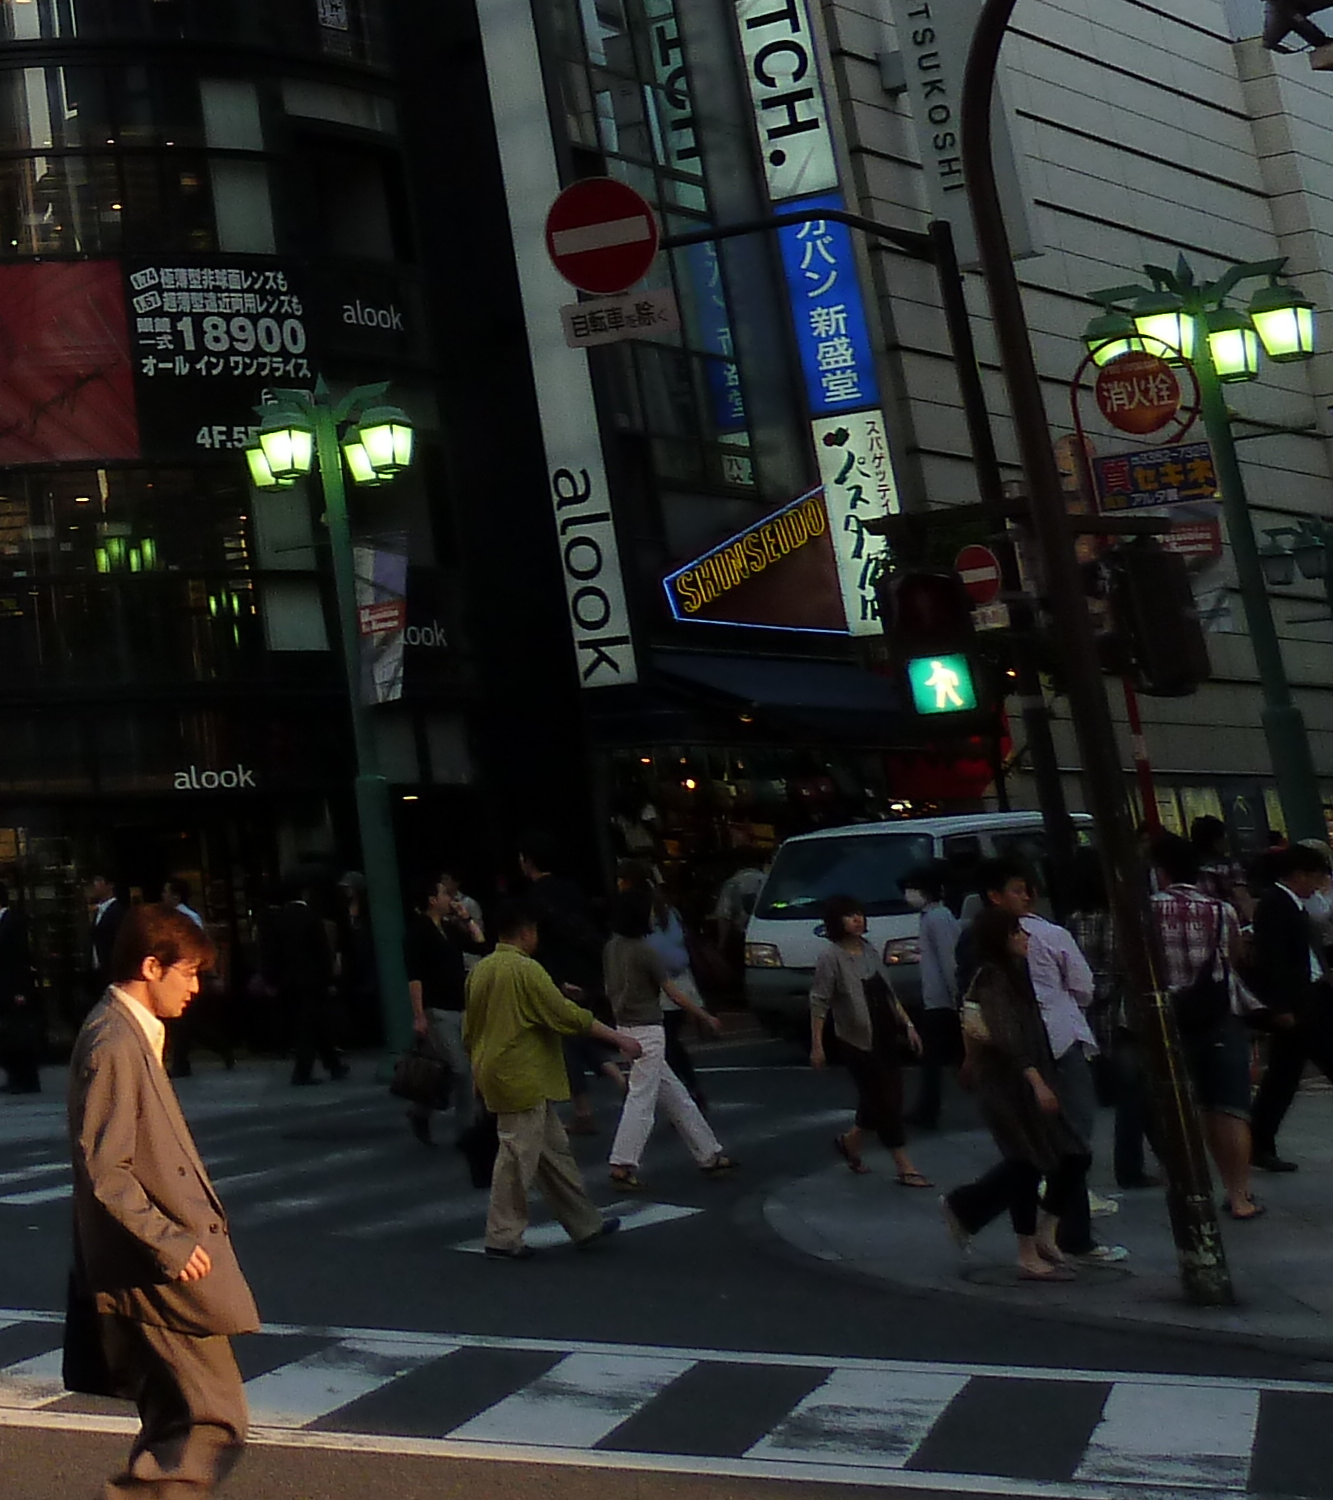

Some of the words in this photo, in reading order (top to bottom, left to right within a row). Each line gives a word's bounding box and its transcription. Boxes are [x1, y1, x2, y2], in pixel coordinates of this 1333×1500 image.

[160, 267, 288, 292] 極薄型非球面レンズも
[163, 291, 304, 317] 超薄型遠近両用レンズも
[341, 300, 405, 332] alook
[570, 300, 671, 339] 自転車を除く
[138, 334, 175, 351] 一式
[176, 316, 308, 355] 18900
[141, 355, 191, 378] オール
[194, 356, 225, 377] イン
[229, 356, 312, 379] ワンプライス
[809, 304, 863, 405] 新盛堂
[1101, 372, 1177, 413] 消火栓
[675, 498, 827, 613] SHINSEIDO
[551, 468, 633, 682] alook
[174, 763, 256, 791] alook
